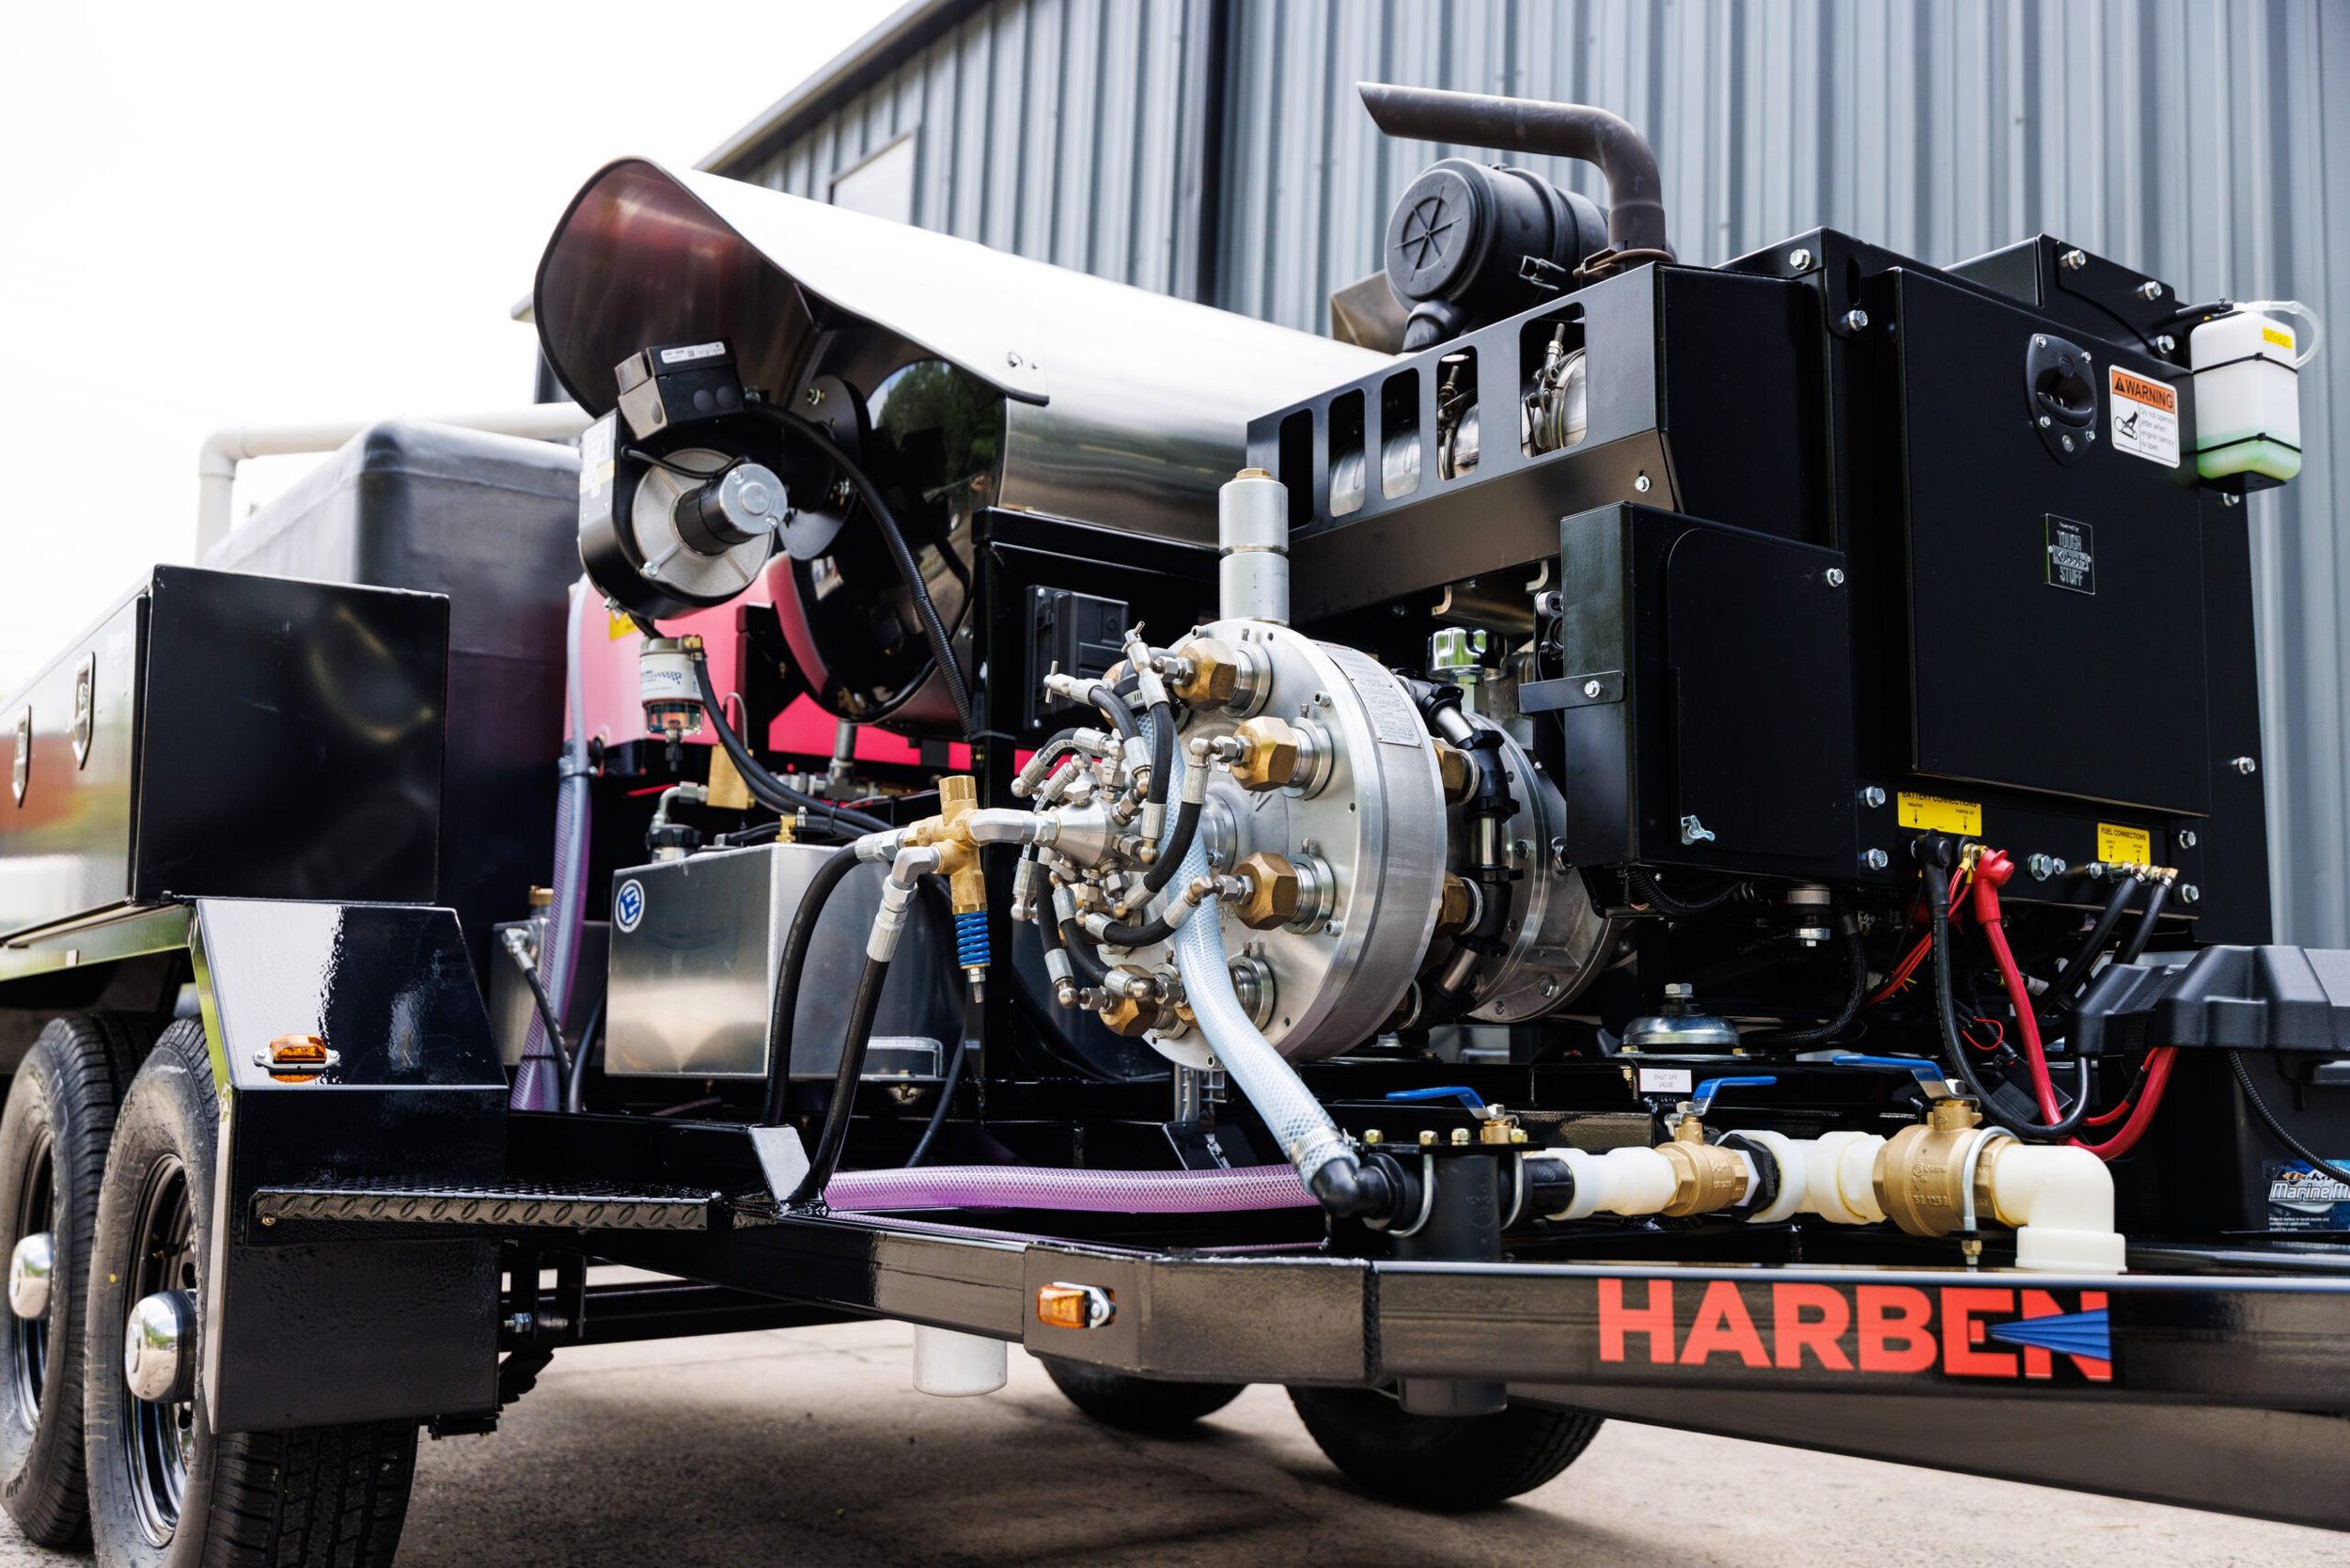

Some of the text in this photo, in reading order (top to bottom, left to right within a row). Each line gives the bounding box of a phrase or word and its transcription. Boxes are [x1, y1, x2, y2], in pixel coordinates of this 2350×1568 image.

[2125, 379, 2173, 408] WARNING
[2057, 530, 2082, 552] TOUGH
[2055, 548, 2088, 569] Kubota
[2059, 566, 2083, 587] STUFF
[1902, 792, 1932, 801] BATTERY
[2101, 827, 2147, 840] FUEL CONNECTIONS
[2269, 1182, 2330, 1200] Marine
[1598, 1278, 2113, 1382] HARBEN
